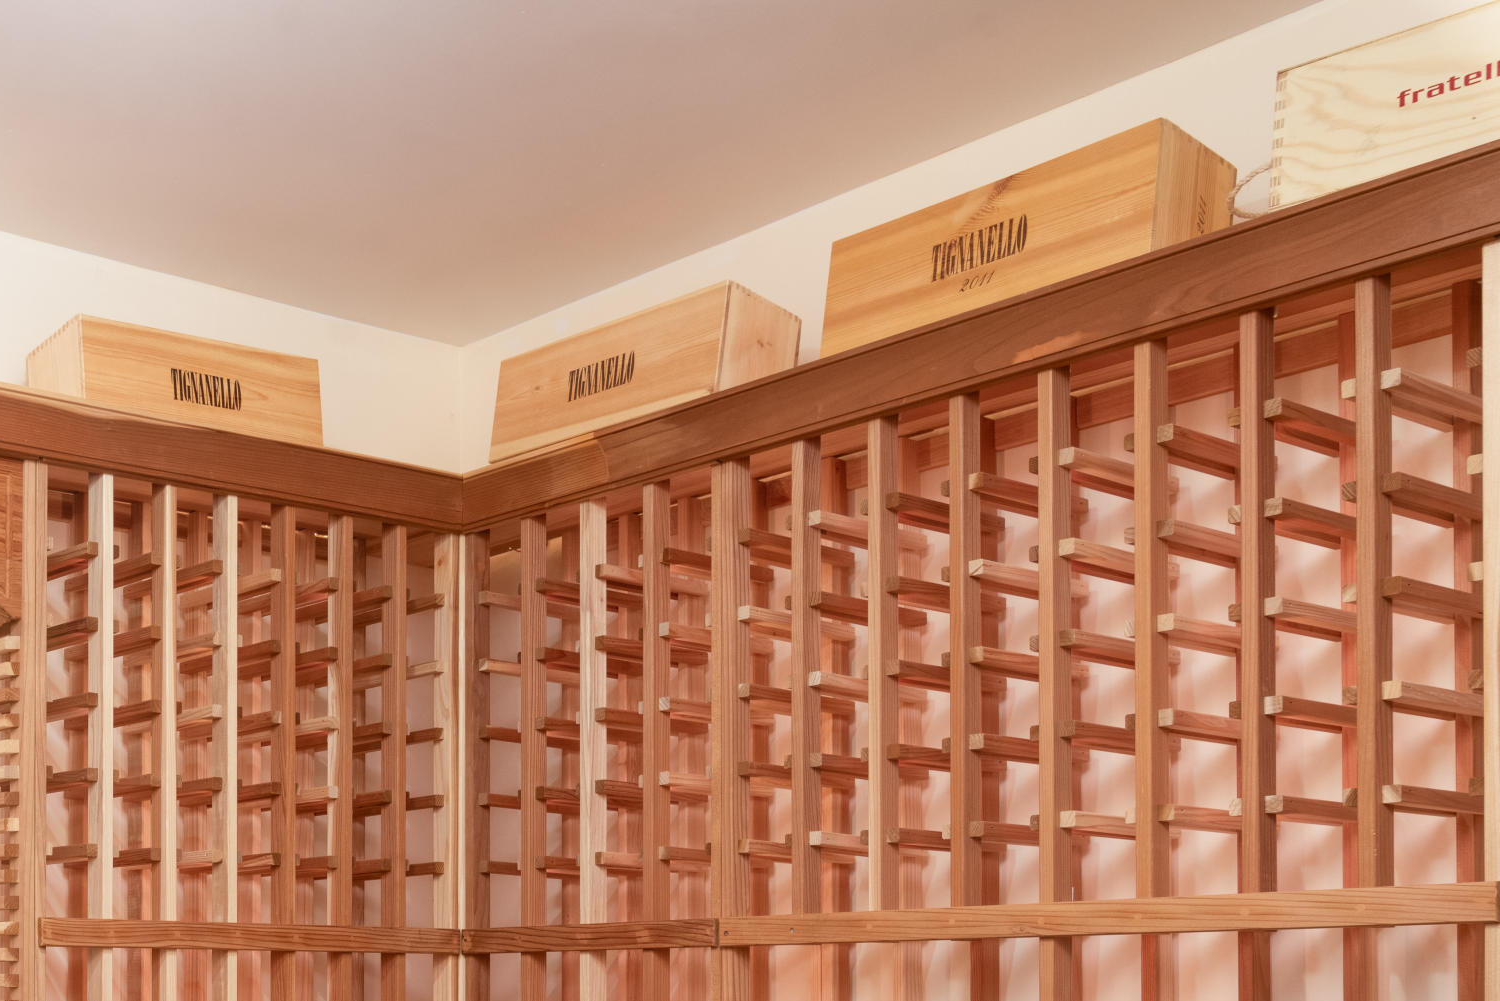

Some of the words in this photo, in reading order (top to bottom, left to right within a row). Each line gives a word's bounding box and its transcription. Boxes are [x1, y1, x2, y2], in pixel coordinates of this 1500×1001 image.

[931, 213, 1028, 283] TIGNANELLO
[958, 270, 996, 293] 2011
[170, 367, 242, 412] TIGNANELLO
[567, 350, 635, 403] TIGNANELLO
